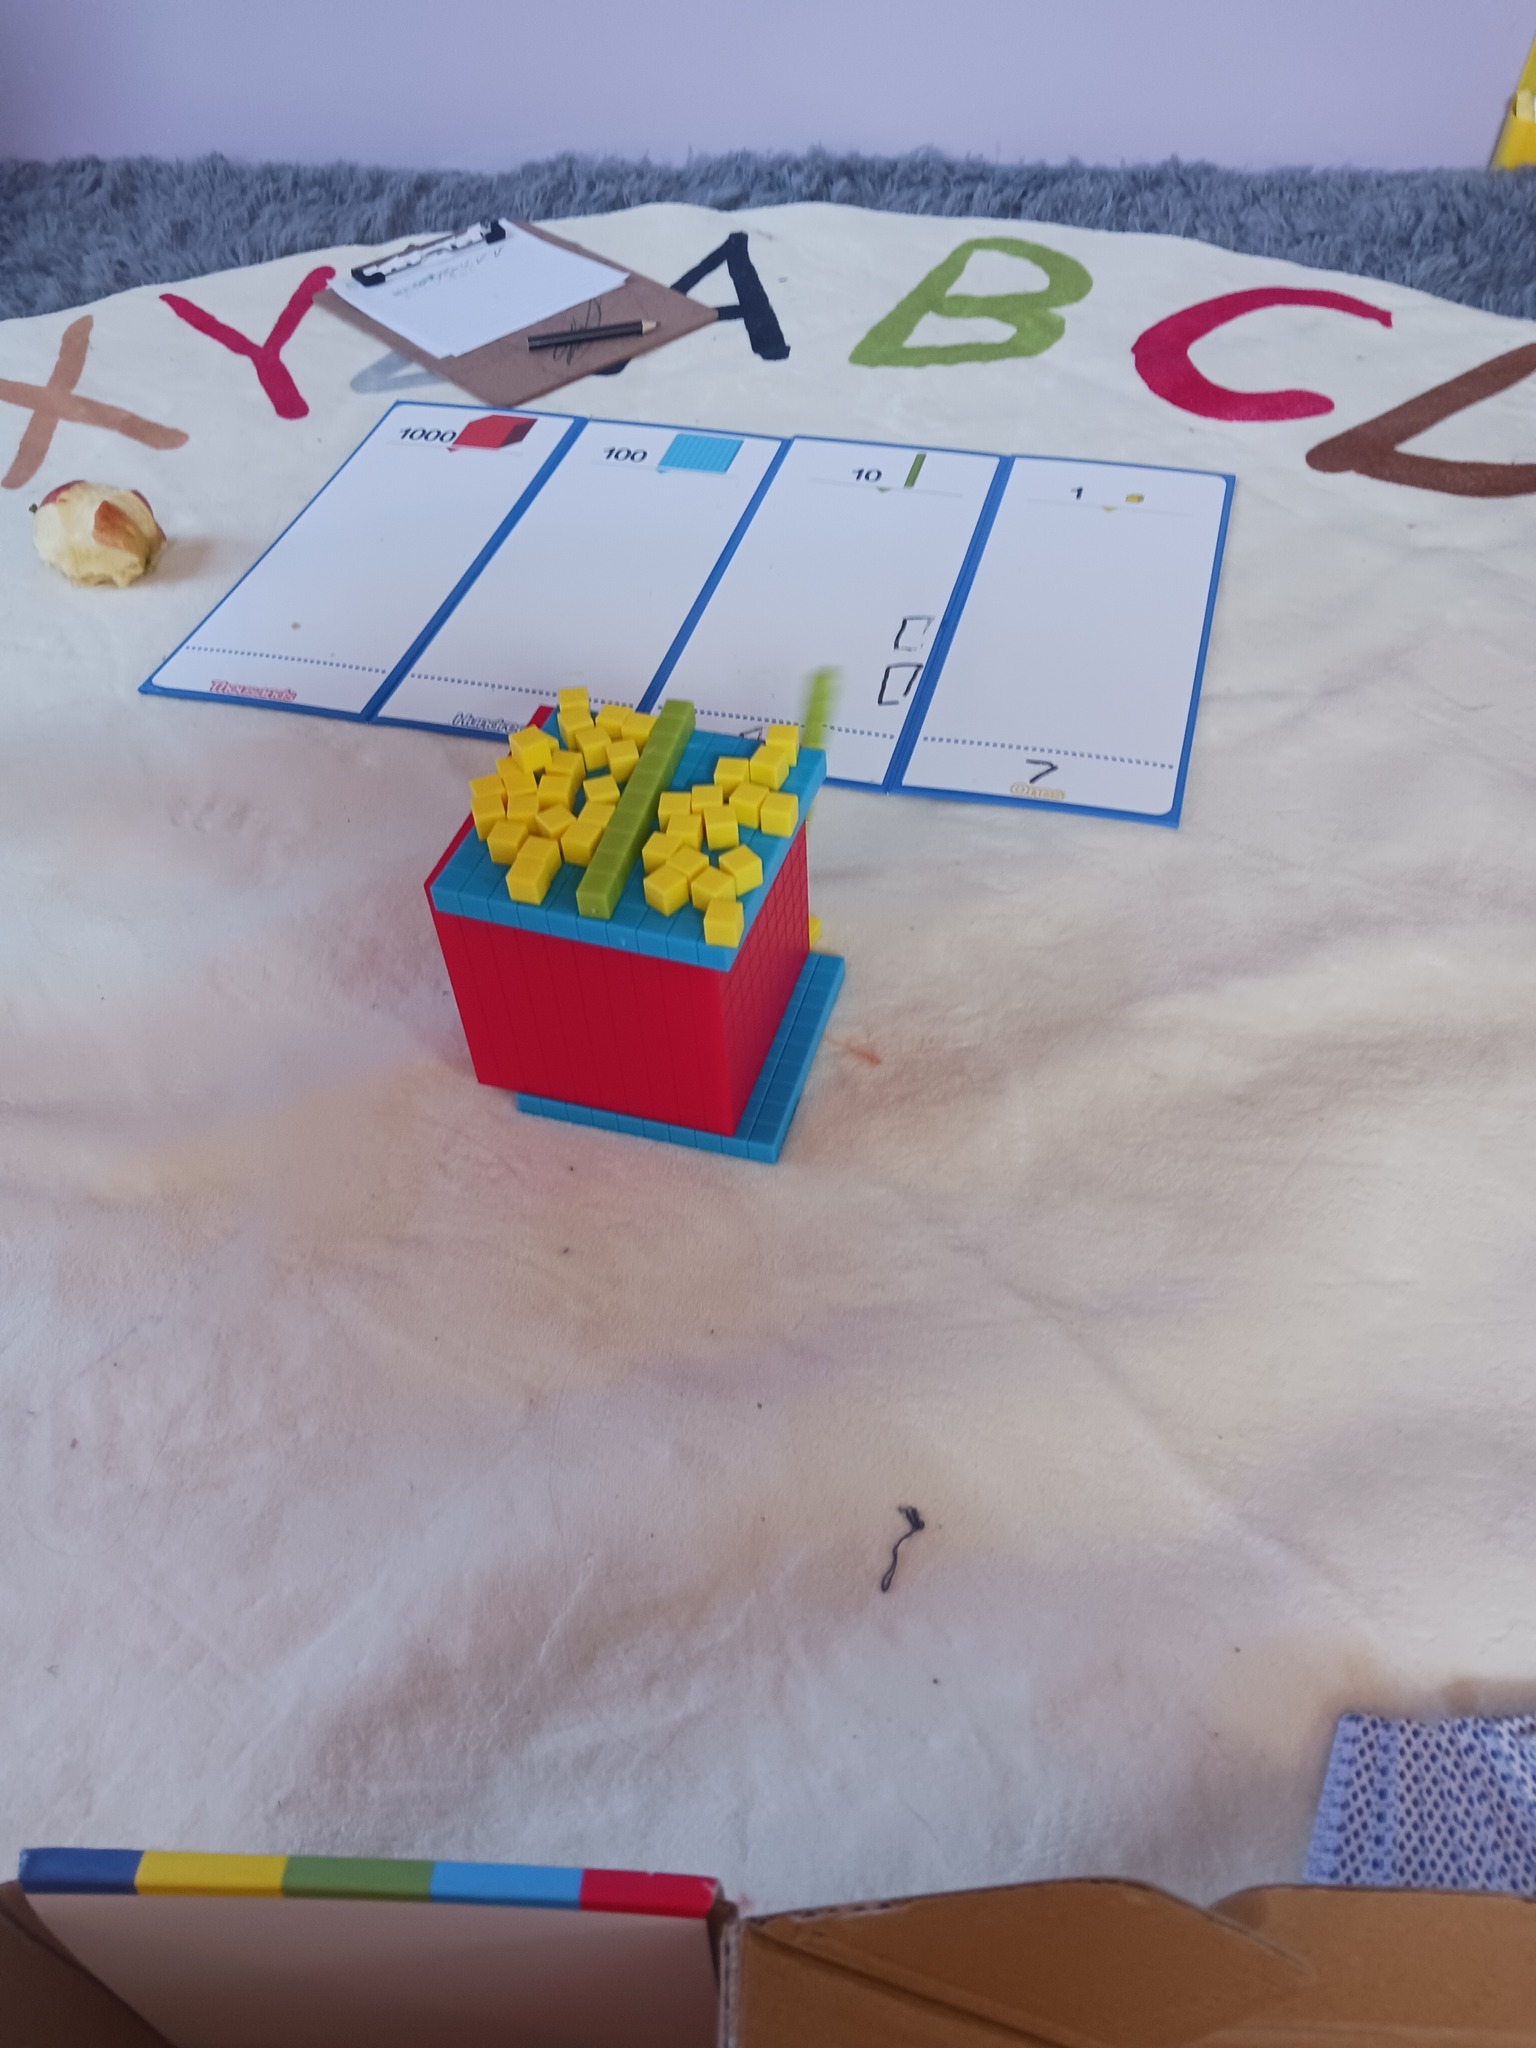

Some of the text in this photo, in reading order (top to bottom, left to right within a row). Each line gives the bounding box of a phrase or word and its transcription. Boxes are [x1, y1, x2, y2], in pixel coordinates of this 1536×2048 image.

[0, 315, 189, 489] X
[159, 265, 329, 420] Y
[594, 231, 790, 376] A
[849, 237, 1093, 367] B
[1132, 286, 1392, 422] C
[400, 427, 456, 443] 1000
[603, 447, 647, 463] 100
[853, 468, 882, 483] 10
[1071, 486, 1083, 500] 1
[1025, 758, 1059, 784] 7
